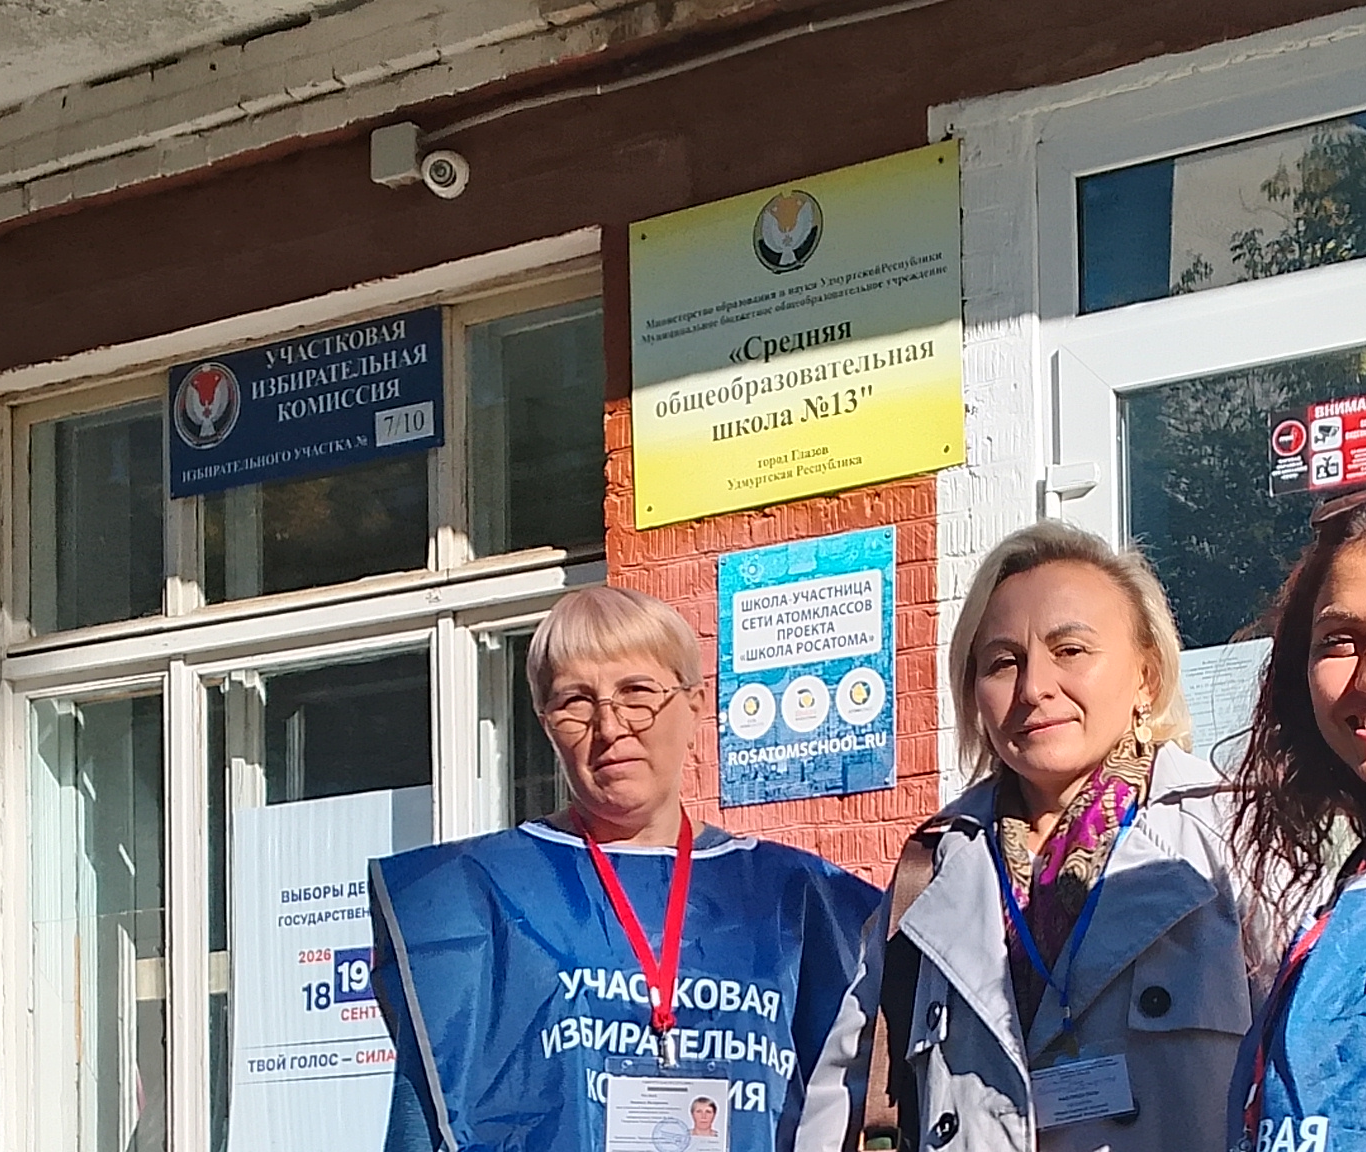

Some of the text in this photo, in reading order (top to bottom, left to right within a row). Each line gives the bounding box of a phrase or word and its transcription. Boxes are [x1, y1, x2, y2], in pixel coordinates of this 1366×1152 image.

[641, 320, 719, 346] Муниципальное
[774, 280, 884, 312] общеобразовательное
[886, 264, 949, 287] учреждение
[645, 307, 714, 329] Министерство
[715, 291, 777, 313] образования
[778, 288, 786, 298] и
[787, 282, 817, 296] науки
[265, 319, 407, 370] УЧАСТКОВАЯ
[728, 320, 852, 365] «Средняя
[251, 343, 427, 400] ИЗБИРАТЕЛЬНАЯ
[655, 339, 935, 419] общеобразовательная
[277, 378, 401, 422] КОМИССИЯ
[711, 407, 794, 442] школа
[181, 409, 425, 483] ИЗБИРАТЕЛЬНОГО УЧАСТКА № 7/10
[757, 446, 830, 470] город Глазов
[727, 456, 863, 491] Удмуртская Республика
[740, 580, 873, 613] ШКОЛА-УЧАСТНИЦА
[741, 598, 873, 631] СЕТИ АТОМКЛАССОВ
[776, 620, 836, 641] ПРОЕКТА
[739, 632, 875, 662] «ШКОЛА РОСАТОМА»
[727, 731, 887, 766] ROSATOMSCHOOL.RU
[280, 880, 366, 904] ВЫБОРЫ ДЕ
[298, 949, 332, 964] 2026
[301, 960, 370, 1012] 18 19
[340, 1005, 383, 1021] СЕНТ
[247, 1054, 286, 1073] ТВОЙ
[289, 1052, 339, 1070] ГОЛОС
[355, 1048, 397, 1064] СИЛА
